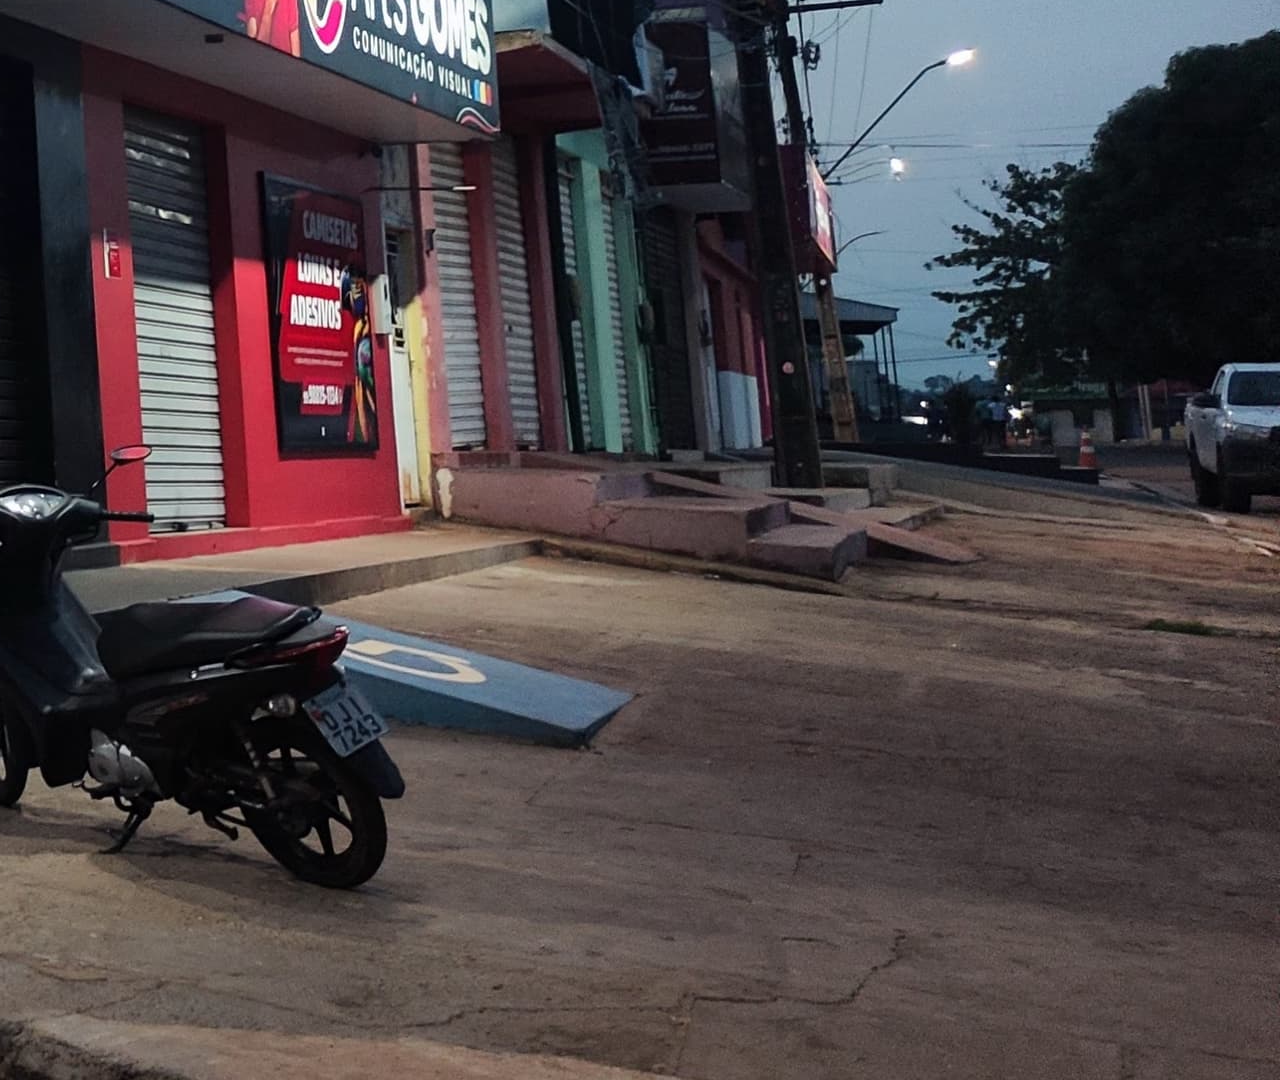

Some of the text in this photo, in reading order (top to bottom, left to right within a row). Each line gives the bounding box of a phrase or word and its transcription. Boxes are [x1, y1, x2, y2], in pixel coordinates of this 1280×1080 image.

[353, 26, 473, 99] COMUNICAÇÃO VISUAL
[303, 209, 358, 250] CAMISETAS
[297, 252, 333, 287] LONAS
[290, 294, 342, 331] ADESIVOS
[332, 713, 382, 752] 7243
